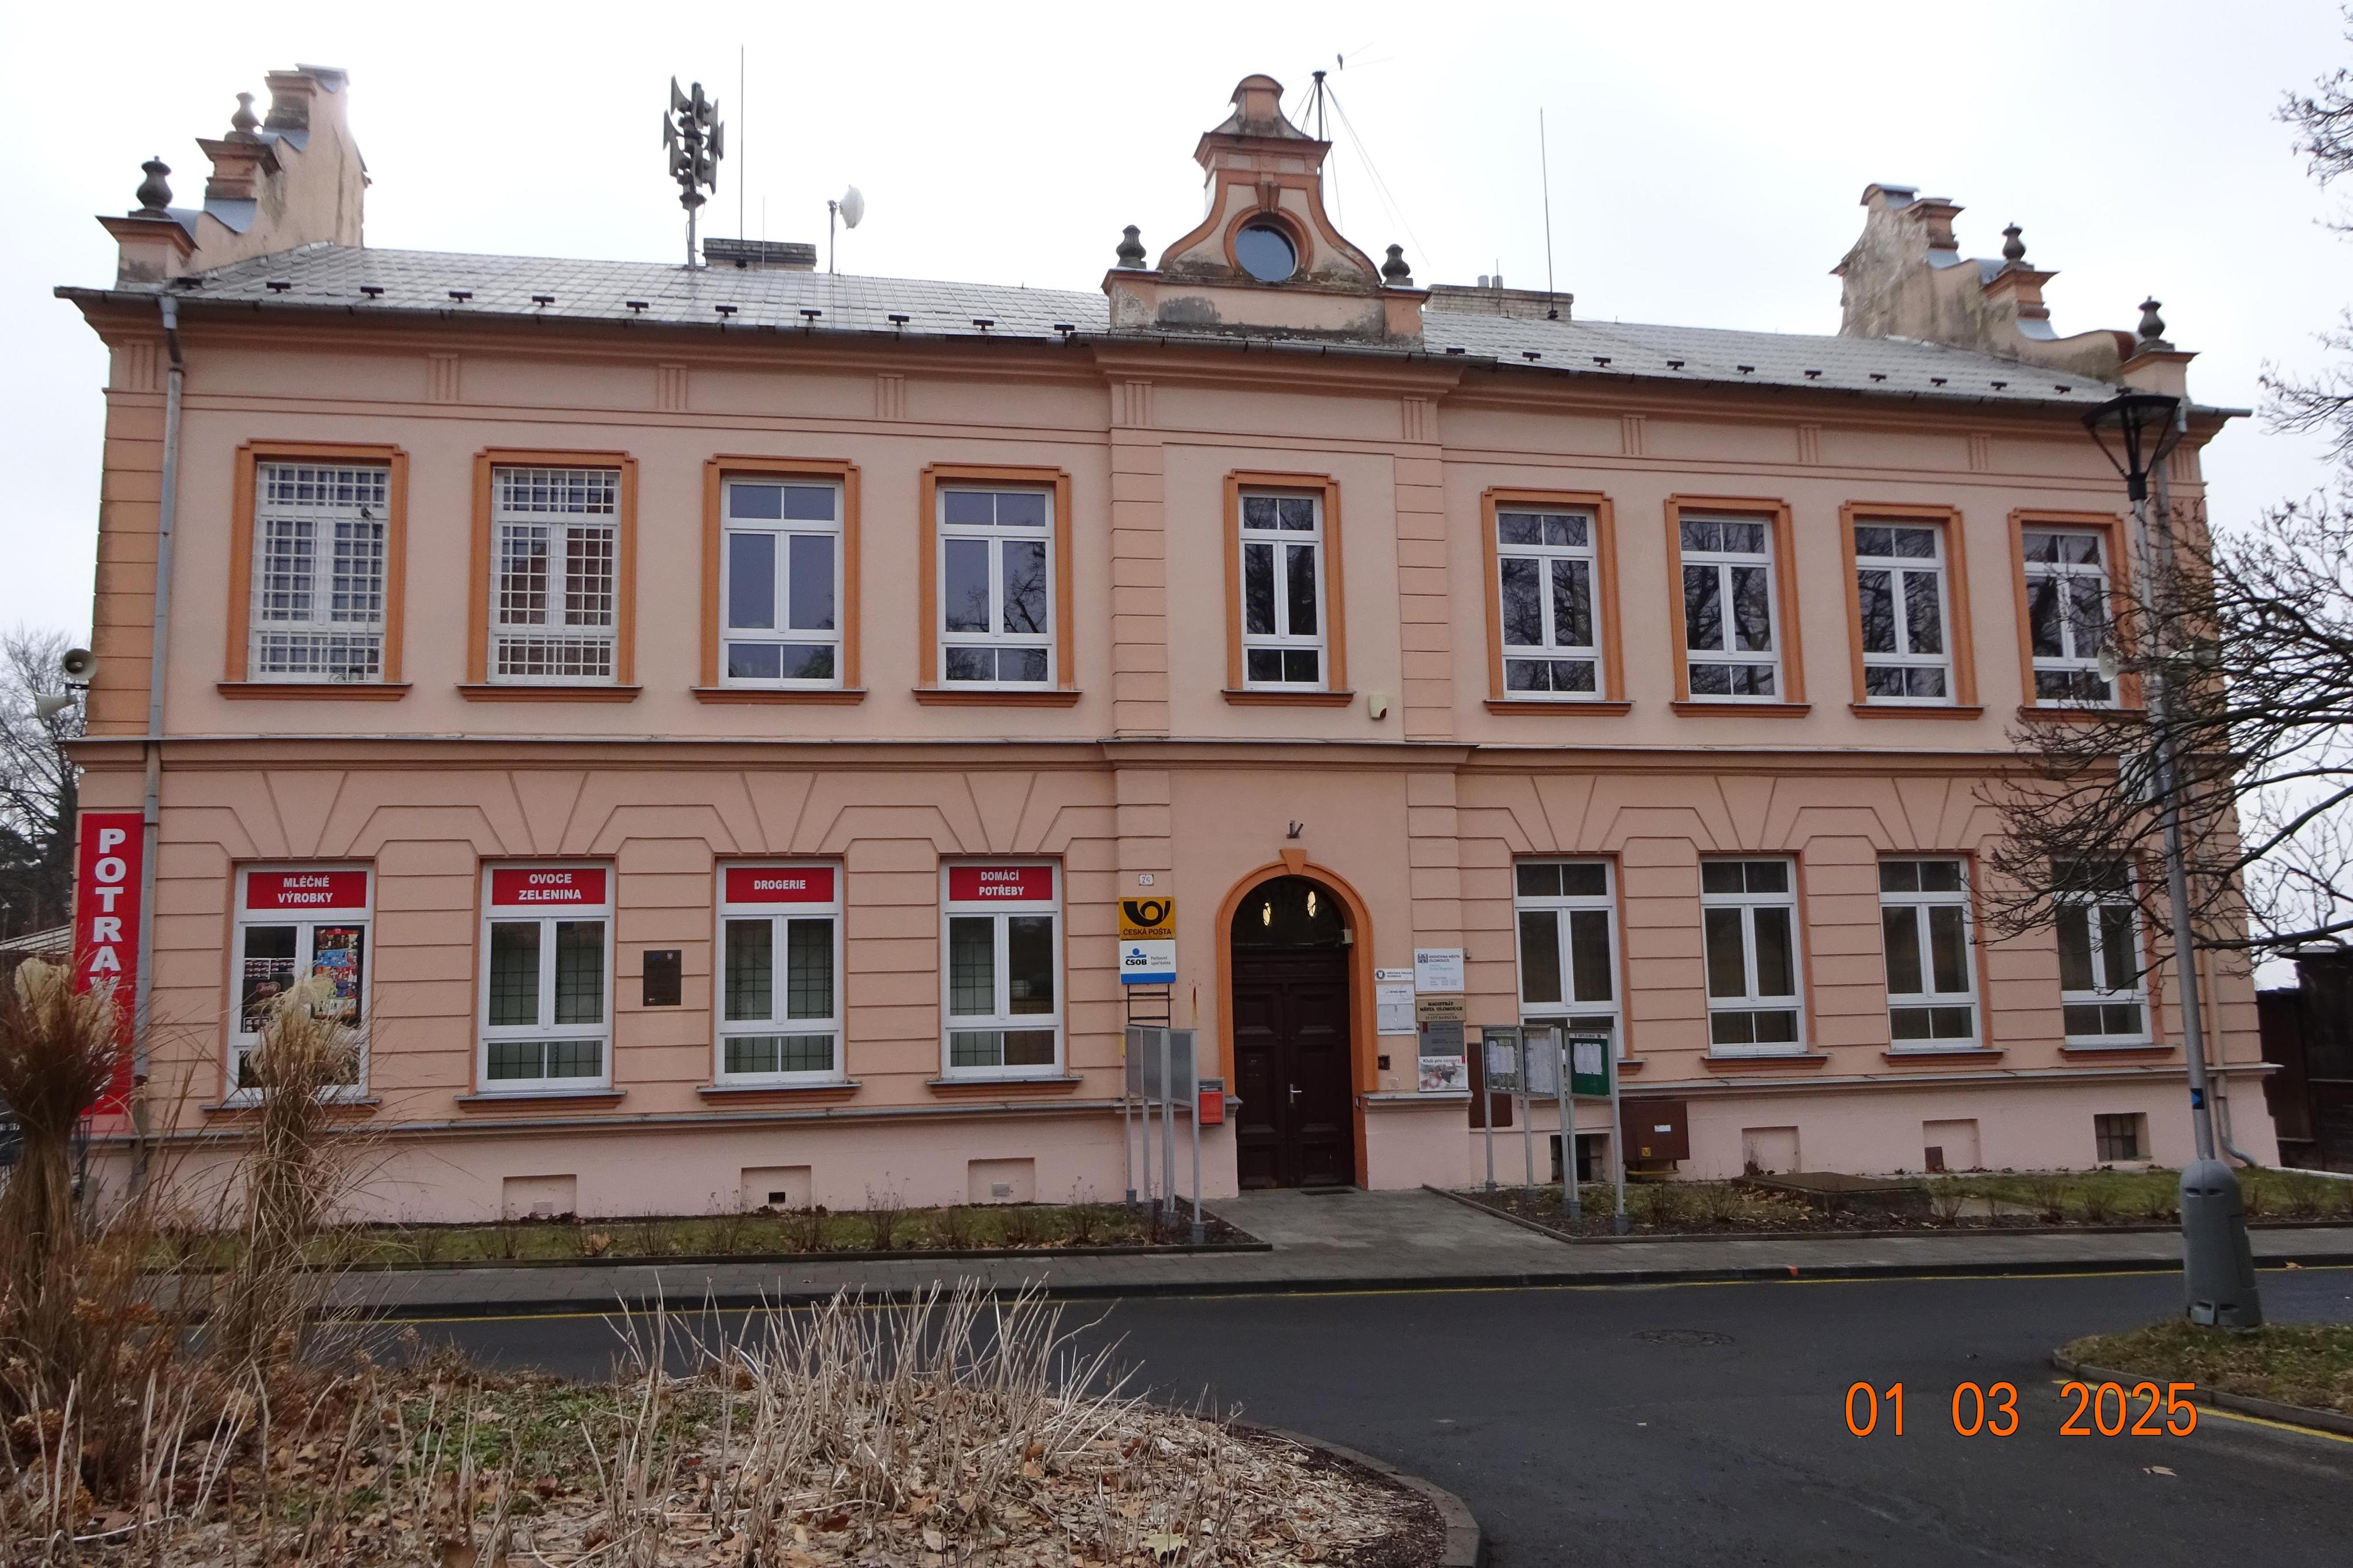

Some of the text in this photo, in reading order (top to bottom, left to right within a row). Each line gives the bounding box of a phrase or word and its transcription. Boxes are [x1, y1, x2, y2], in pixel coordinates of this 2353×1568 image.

[529, 873, 572, 884] OVOCE
[981, 870, 1019, 880] DOMÁCÍ
[284, 875, 329, 888] MLÉČNÉ
[754, 880, 806, 890] DROGERIE
[518, 889, 582, 900] ZELENINA
[979, 884, 1024, 896] POTŘEBY
[278, 891, 333, 903] VÝROBKY
[1123, 928, 1147, 936] ČESKÁ
